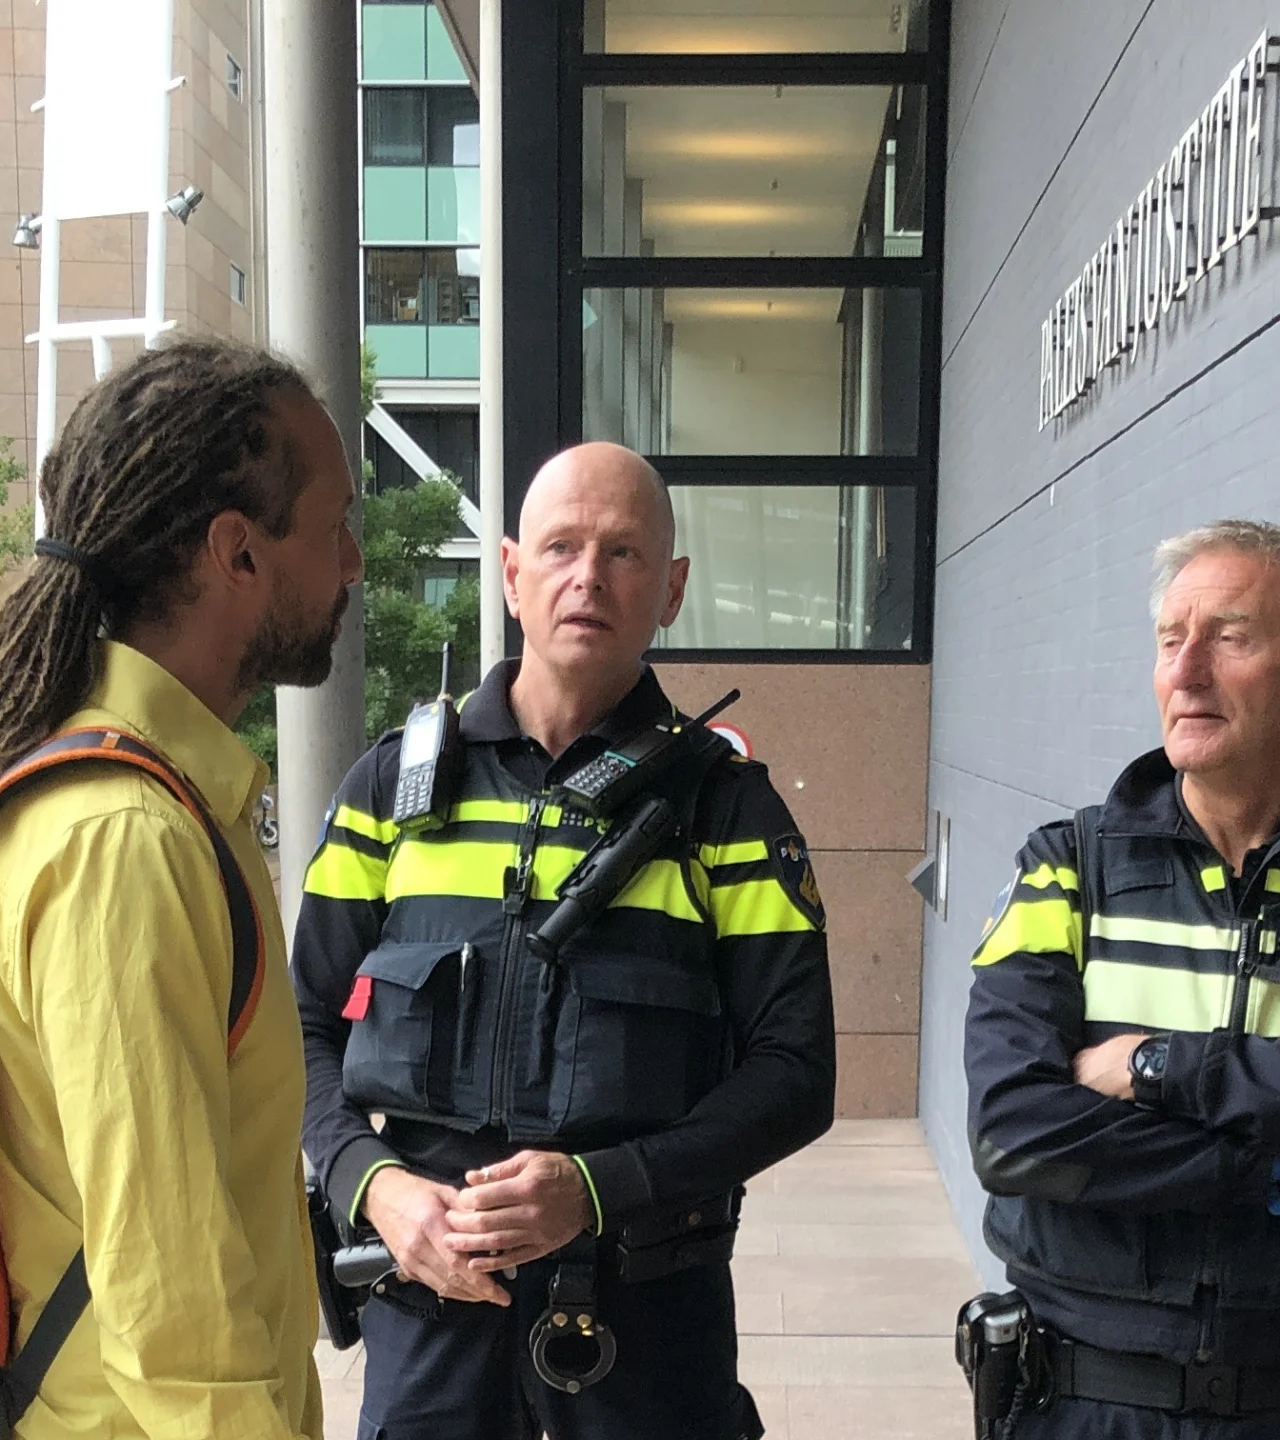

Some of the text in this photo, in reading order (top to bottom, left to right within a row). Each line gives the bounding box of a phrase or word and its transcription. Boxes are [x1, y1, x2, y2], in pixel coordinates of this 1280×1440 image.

[1039, 28, 1268, 433] PALEIS VAN JUSTITIE
